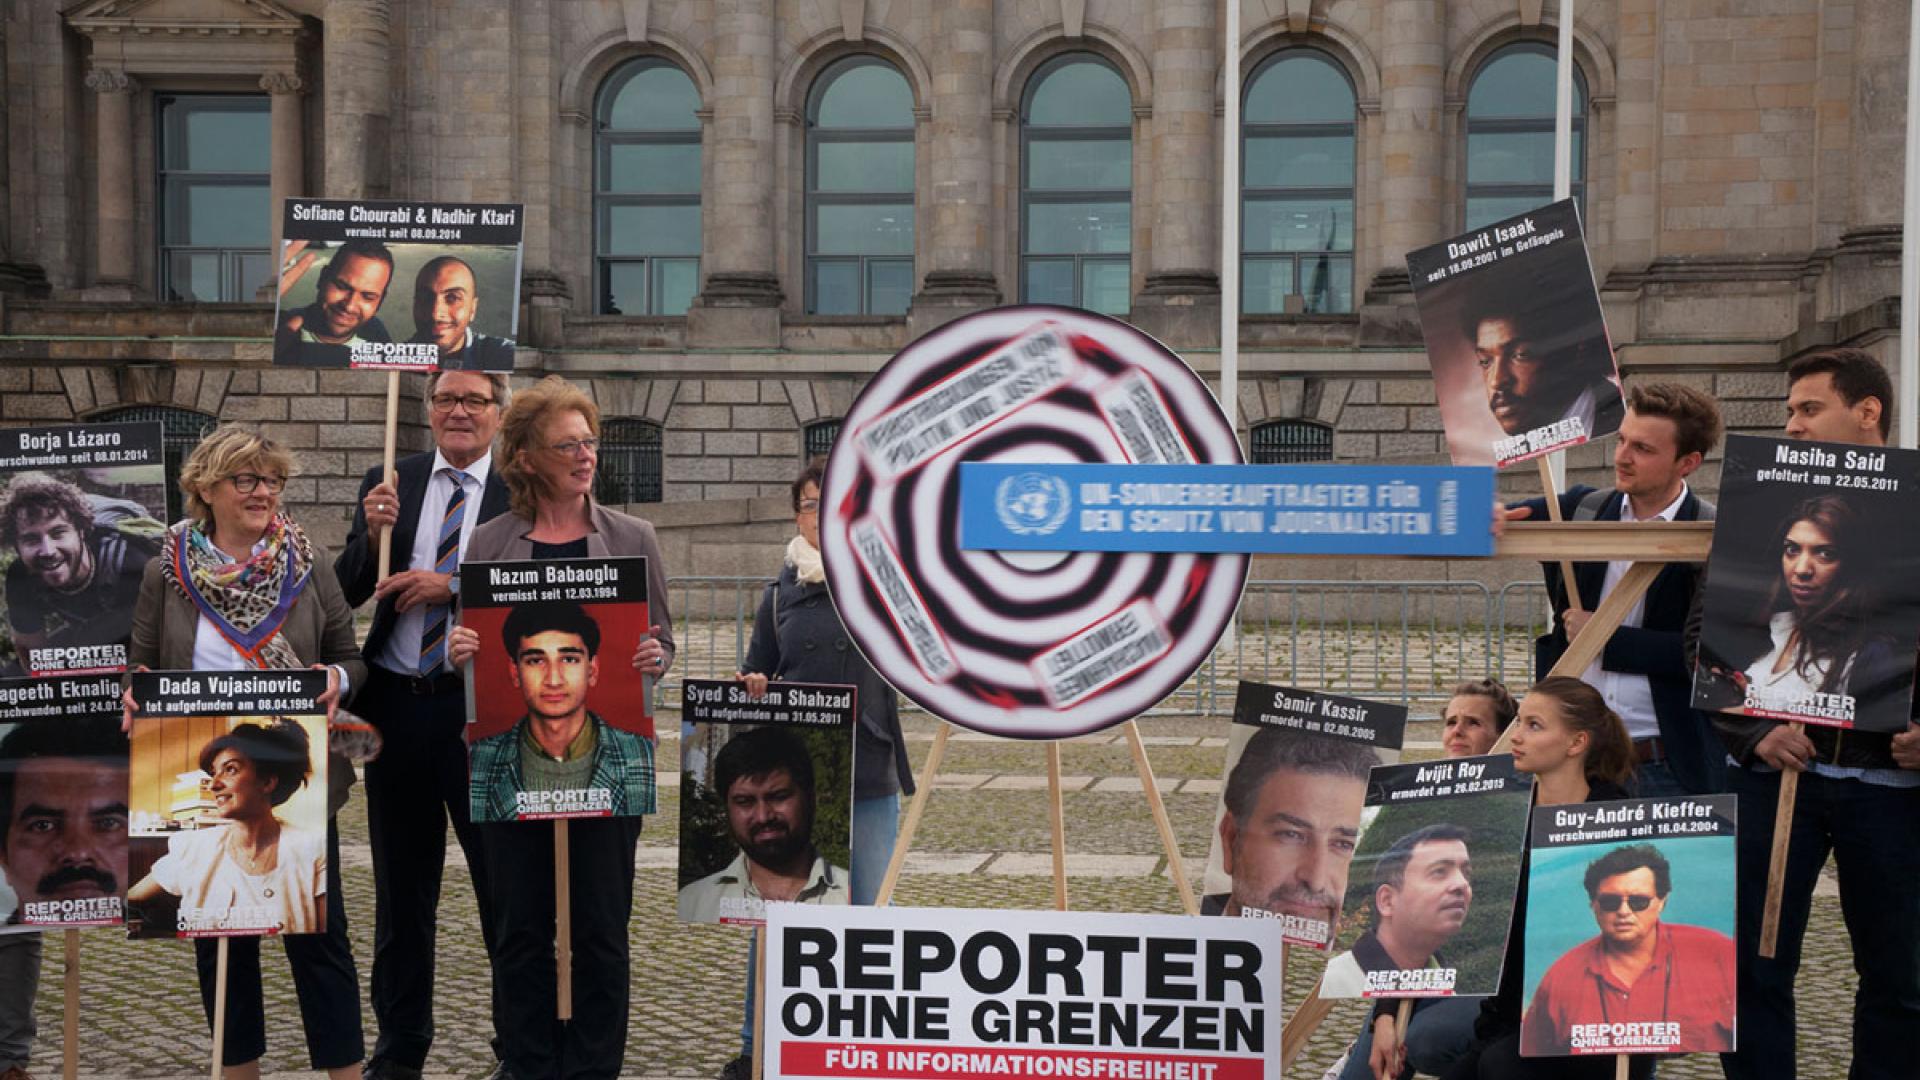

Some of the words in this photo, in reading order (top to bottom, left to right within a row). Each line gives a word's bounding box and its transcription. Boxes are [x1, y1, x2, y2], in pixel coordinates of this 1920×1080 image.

[293, 204, 344, 221] Sofiane
[350, 206, 410, 223] Chourabi
[416, 208, 427, 223] &
[432, 209, 476, 225] Nadhir
[481, 210, 515, 226] Ktari
[345, 227, 386, 238] vermisst
[389, 228, 408, 238] seit
[411, 229, 461, 240] 08.09.2014
[1447, 232, 1491, 259] Dawit
[1495, 218, 1536, 243] Isaak
[1428, 267, 1446, 282] seit
[1501, 246, 1514, 257] im
[1516, 228, 1565, 252] Gefängnis
[351, 354, 382, 363] OHNE
[385, 355, 438, 364] GRENZEN
[352, 343, 438, 356] REPORTER
[19, 432, 61, 452] Borja
[68, 430, 121, 448] Lázaro
[71, 451, 91, 464] seit
[94, 449, 148, 463] 08.01.2014
[1776, 445, 1837, 468] Nasiha
[1844, 450, 1886, 472] Said
[1757, 468, 1808, 483] gefoltert
[1813, 475, 1831, 485] am
[1835, 474, 1898, 491] 22.05.2011
[1376, 480, 1421, 507] FÜR
[1080, 510, 1124, 532] DEN
[1129, 510, 1214, 532] SCHUTZ
[1219, 511, 1265, 533] VON
[1270, 512, 1432, 534] JOURNALISTEN
[546, 564, 618, 585] Babaoglu
[492, 589, 537, 602] vermisst
[541, 588, 560, 600] seit
[565, 587, 617, 599] 12.03.1994
[29, 644, 126, 661] REPORTER
[31, 660, 65, 671] OHNE
[68, 656, 127, 668] GRENZEN
[60, 679, 122, 699] Eknalig
[159, 677, 200, 695] Dada
[208, 676, 302, 697] Vujasinovic
[146, 700, 162, 712] tot
[166, 699, 233, 713] aufgefunden
[238, 700, 254, 710] am
[258, 698, 314, 710] 08.04.1994
[687, 685, 722, 703] Syed
[729, 686, 781, 705] Salem
[788, 690, 850, 708] Shahzad
[66, 702, 86, 714] seit
[694, 707, 709, 717] tot
[712, 708, 770, 721] aufgefunden
[774, 712, 789, 721] am
[792, 711, 841, 724] 31.05.2011
[1273, 692, 1316, 714] Samir
[1321, 700, 1368, 722] Kassir
[1788, 704, 1855, 720] GRENZEN
[1260, 714, 1303, 728] ermordet
[1306, 721, 1320, 731] am
[1416, 764, 1453, 784] Avijit
[1458, 762, 1486, 779] Roy
[517, 788, 610, 804] REPORTER
[1392, 786, 1434, 800] ermordet
[1437, 786, 1451, 795] am
[1454, 778, 1504, 793] 26.02.2015
[517, 803, 552, 813] OHNE
[555, 801, 612, 812] GRENZEN
[1555, 804, 1644, 828] Guy-André
[1652, 802, 1713, 820] Kieffer
[1549, 827, 1627, 843] verschwunden
[1632, 824, 1653, 837] seit
[25, 896, 121, 915] REPORTER
[64, 909, 122, 921] GRENZEN
[1241, 906, 1328, 930] REPORTER
[782, 926, 1264, 1003] REPORTER
[1368, 969, 1456, 984] REPORTER
[781, 993, 949, 1039] OHNE
[971, 1000, 1264, 1052] GRENZEN
[1571, 1022, 1680, 1037] REPORTER
[1572, 1036, 1609, 1047] OHNE
[1614, 1036, 1680, 1046] GRENZEN
[825, 1045, 878, 1070] FÜR
[888, 1051, 1218, 1080] INFORMATIONSFREIHEIT
